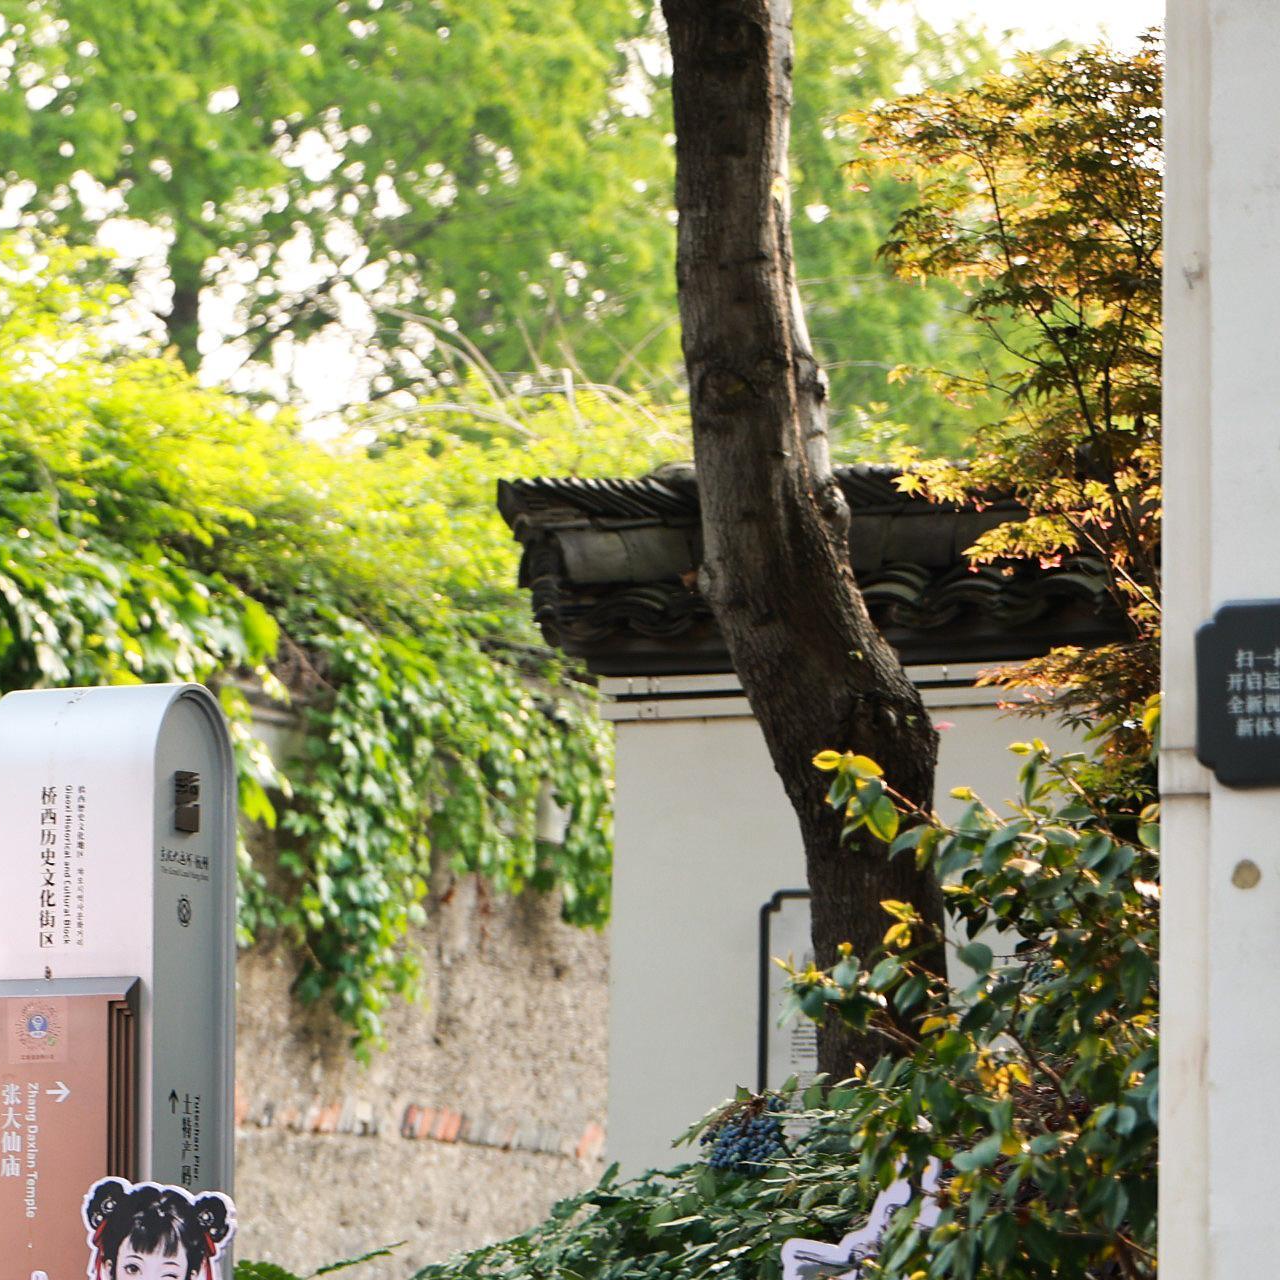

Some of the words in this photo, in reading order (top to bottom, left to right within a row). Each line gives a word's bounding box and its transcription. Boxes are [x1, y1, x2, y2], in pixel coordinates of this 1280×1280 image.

[1235, 648, 1280, 669] 扫一
[64, 785, 73, 813] Qiaoxi
[63, 815, 73, 859] Historical
[40, 785, 57, 949] 桥西历史文化街区
[63, 861, 72, 878] and
[63, 880, 72, 917] Cultural
[63, 919, 72, 944] Block
[25, 1082, 39, 1122] Zhang
[0, 1083, 22, 1177] 张大仙庙
[25, 1124, 39, 1169] Daxian
[25, 1171, 39, 1219] Temple
